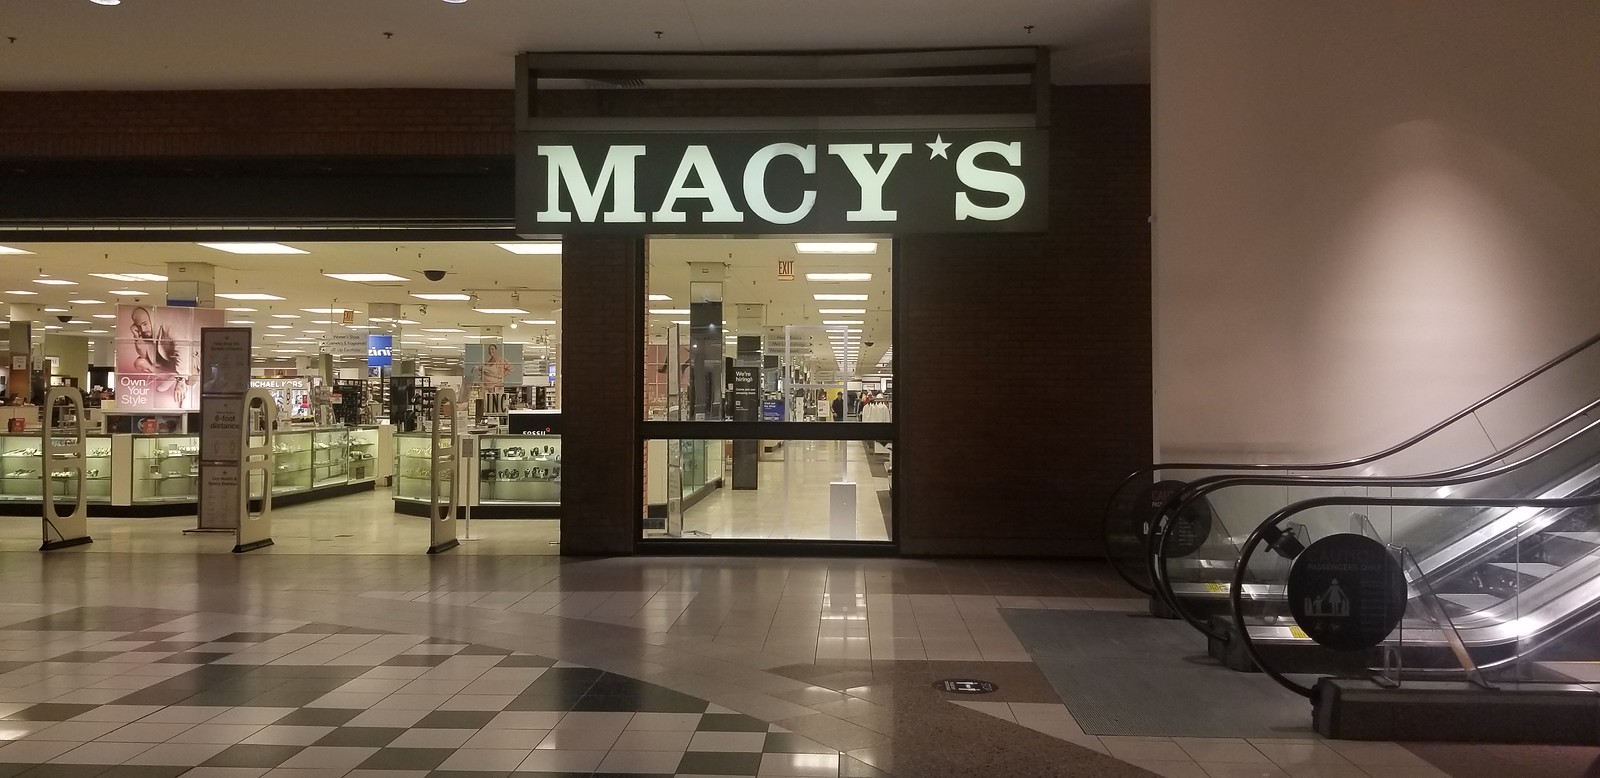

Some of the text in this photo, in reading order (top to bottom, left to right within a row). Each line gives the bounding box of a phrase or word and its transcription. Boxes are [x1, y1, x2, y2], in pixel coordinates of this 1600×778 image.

[537, 134, 1026, 225] MACY'S
[778, 260, 794, 275] EXIT
[120, 376, 146, 387] Own
[127, 385, 150, 396] Your
[121, 394, 147, 407] Style
[486, 393, 507, 413] INC
[210, 422, 240, 430] distance
[1306, 563, 1383, 572] PASSENGERS ONLY
